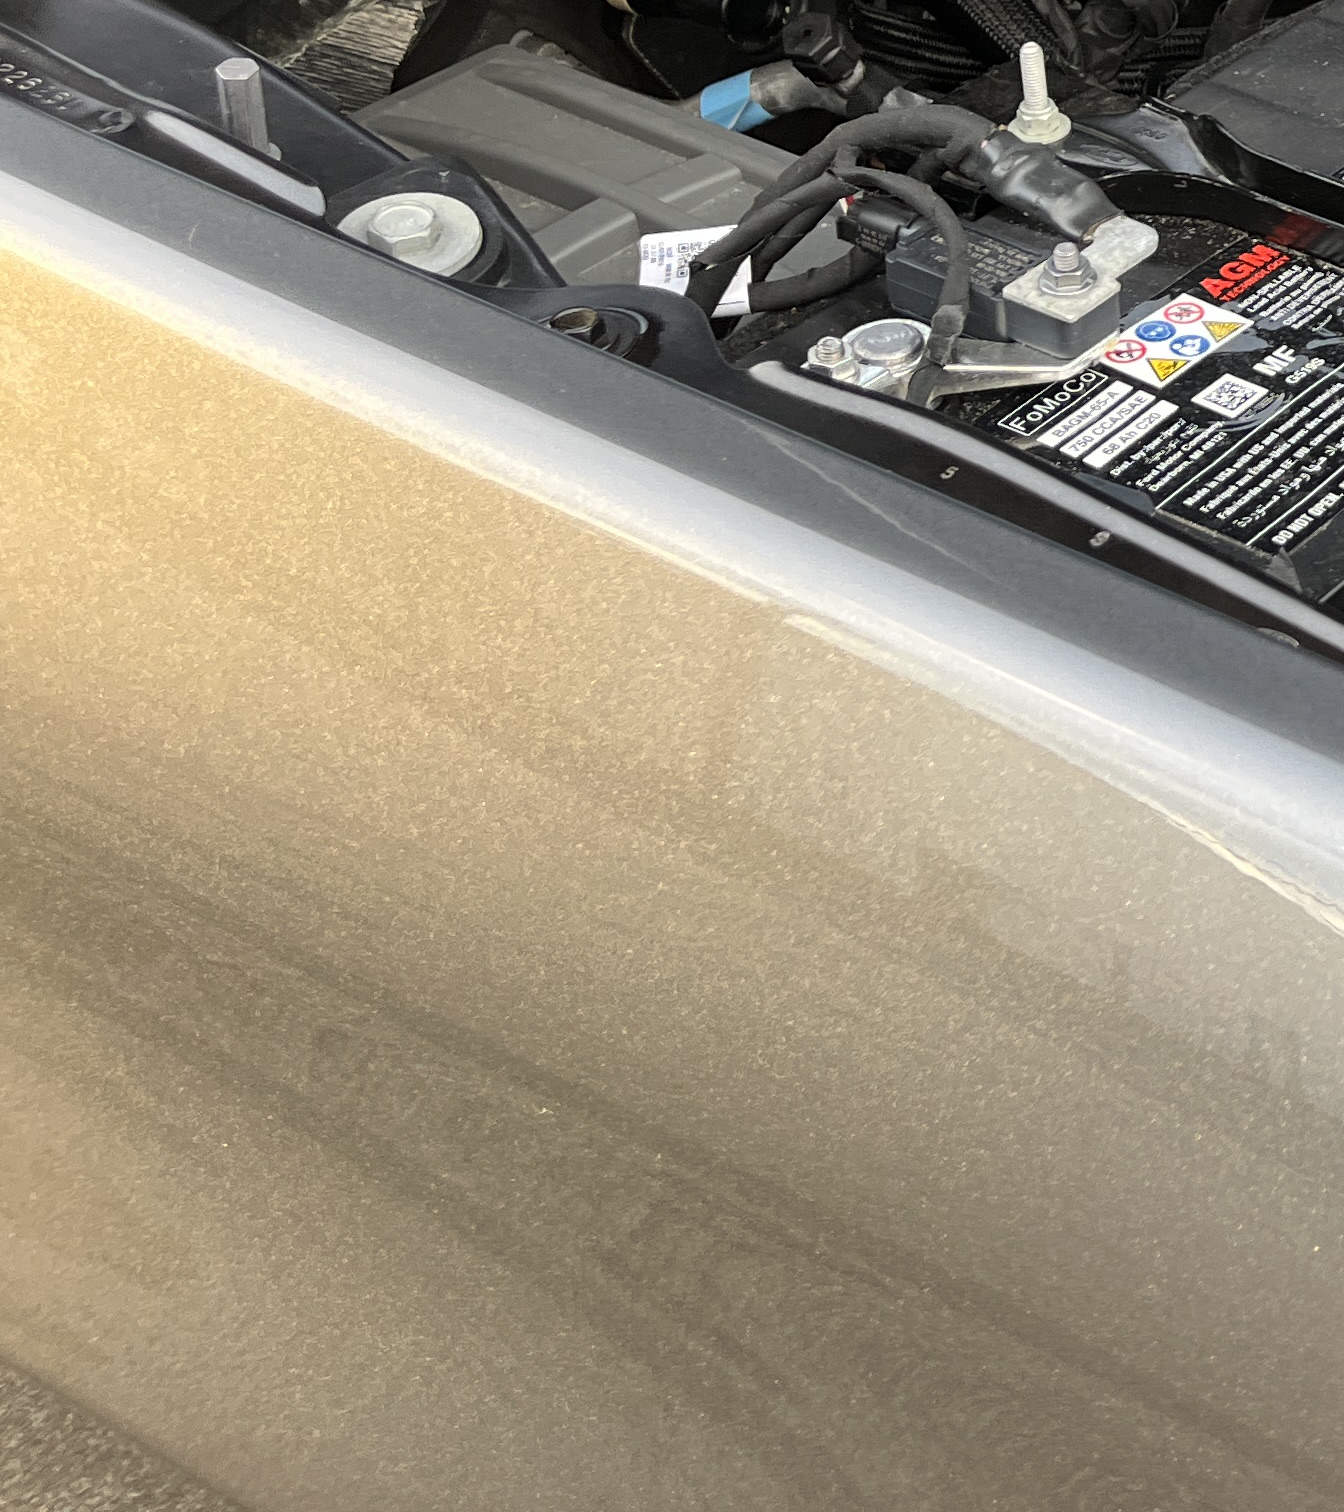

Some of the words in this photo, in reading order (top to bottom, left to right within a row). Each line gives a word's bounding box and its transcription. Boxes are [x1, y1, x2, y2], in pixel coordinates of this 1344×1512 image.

[1193, 241, 1280, 298] AGM
[1219, 253, 1290, 303] TECHNOLOGY
[1236, 264, 1302, 309] NON-SPILLABLE
[1247, 297, 1270, 312] Lead
[1266, 285, 1287, 298] Acid
[1282, 266, 1314, 287] Battery
[1251, 344, 1303, 377] MF
[1007, 369, 1099, 431] FoMoCo
[1051, 390, 1119, 437] BAGM-65-A
[1068, 434, 1095, 451] 750
[1089, 395, 1148, 435] CCA/SAE
[1100, 442, 1121, 455] 68
[1116, 429, 1138, 443] Ah
[1133, 411, 1162, 430] C20
[1133, 469, 1160, 486] Ford
[1154, 449, 1185, 470] Motor
[1178, 419, 1227, 452] Company,
[1181, 486, 1211, 505] Made
[1202, 478, 1220, 489] in
[1212, 466, 1238, 482] USA
[1229, 452, 1254, 469] with
[1247, 443, 1266, 455] US
[1258, 431, 1280, 445] and
[1272, 406, 1314, 434] imported
[1109, 458, 1135, 475] Dist.
[1145, 458, 1195, 492] Dearborn,
[1188, 449, 1205, 460] MI
[1197, 484, 1241, 513] Fabriqué
[1234, 473, 1254, 486] aux
[1244, 441, 1295, 475] États-Unis
[1286, 428, 1310, 444] avec
[1302, 416, 1324, 429] des
[1257, 477, 1274, 488] en
[1266, 467, 1286, 480] los
[1278, 456, 1299, 469] EE.
[1290, 444, 1315, 459] UU.
[1306, 432, 1328, 446] con
[1270, 529, 1295, 545] DO
[1285, 513, 1316, 533] NOT
